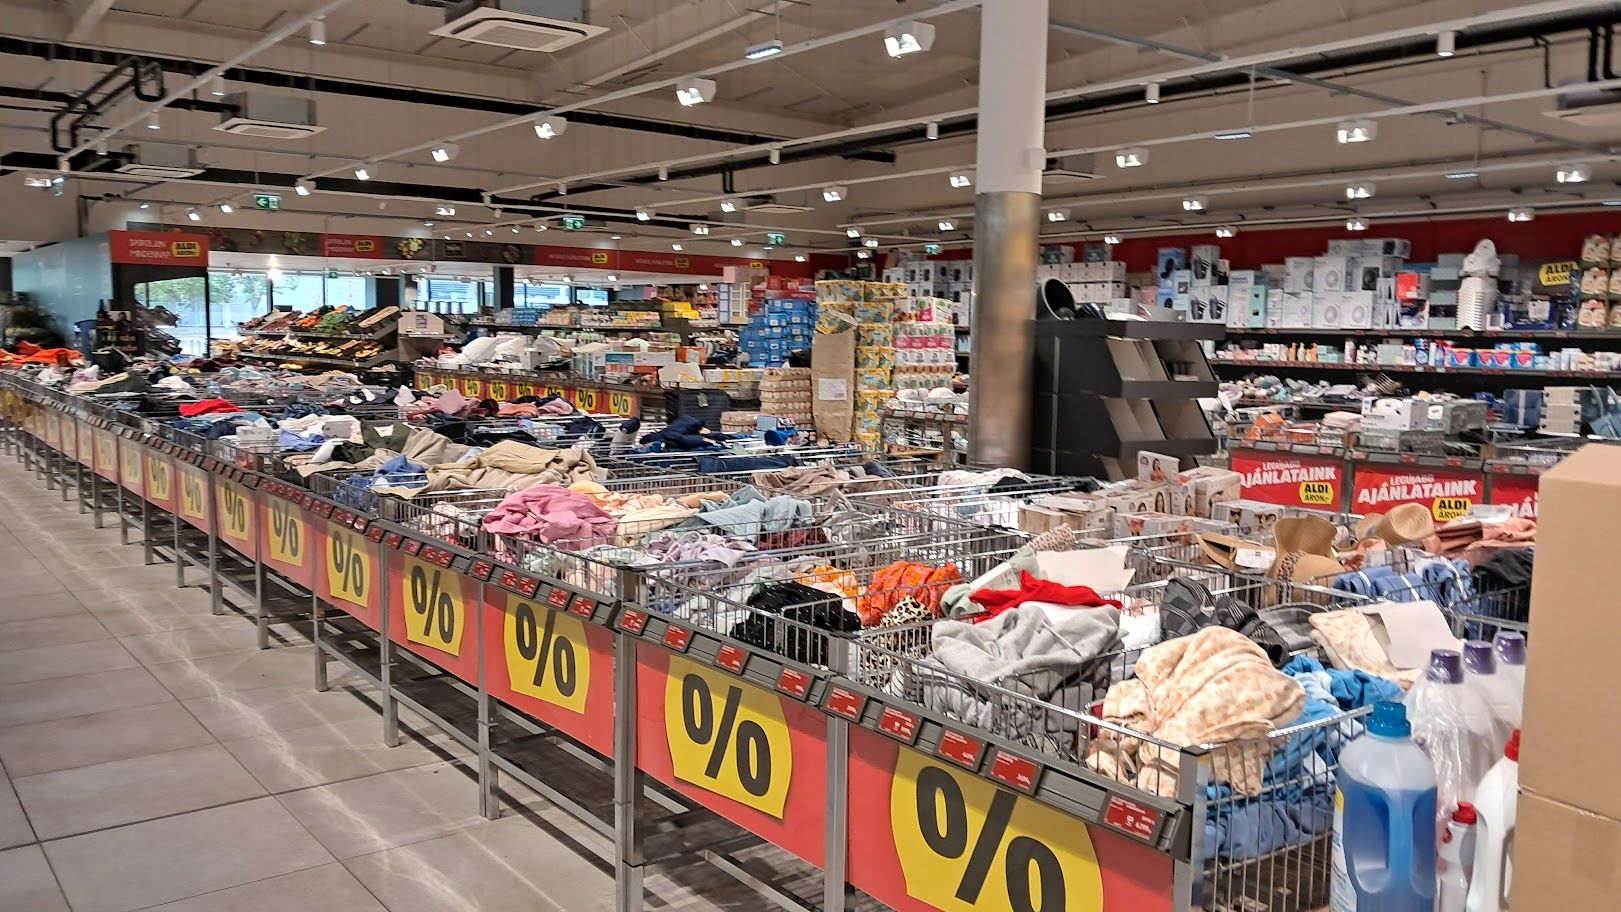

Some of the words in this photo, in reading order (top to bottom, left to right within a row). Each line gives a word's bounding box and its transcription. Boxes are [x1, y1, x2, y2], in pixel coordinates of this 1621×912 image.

[176, 242, 197, 250] ALDI
[579, 389, 592, 408] %
[612, 393, 629, 413] %
[184, 469, 201, 514] %
[223, 482, 246, 533] %
[1304, 483, 1328, 494] ALDI
[1357, 479, 1477, 505] AJÁNLATAINK
[1438, 499, 1467, 510] ALDI
[272, 500, 299, 558] %
[332, 530, 364, 598] %
[411, 565, 455, 644] %
[515, 602, 577, 698] %
[682, 673, 772, 798] %
[915, 765, 1067, 912] %
